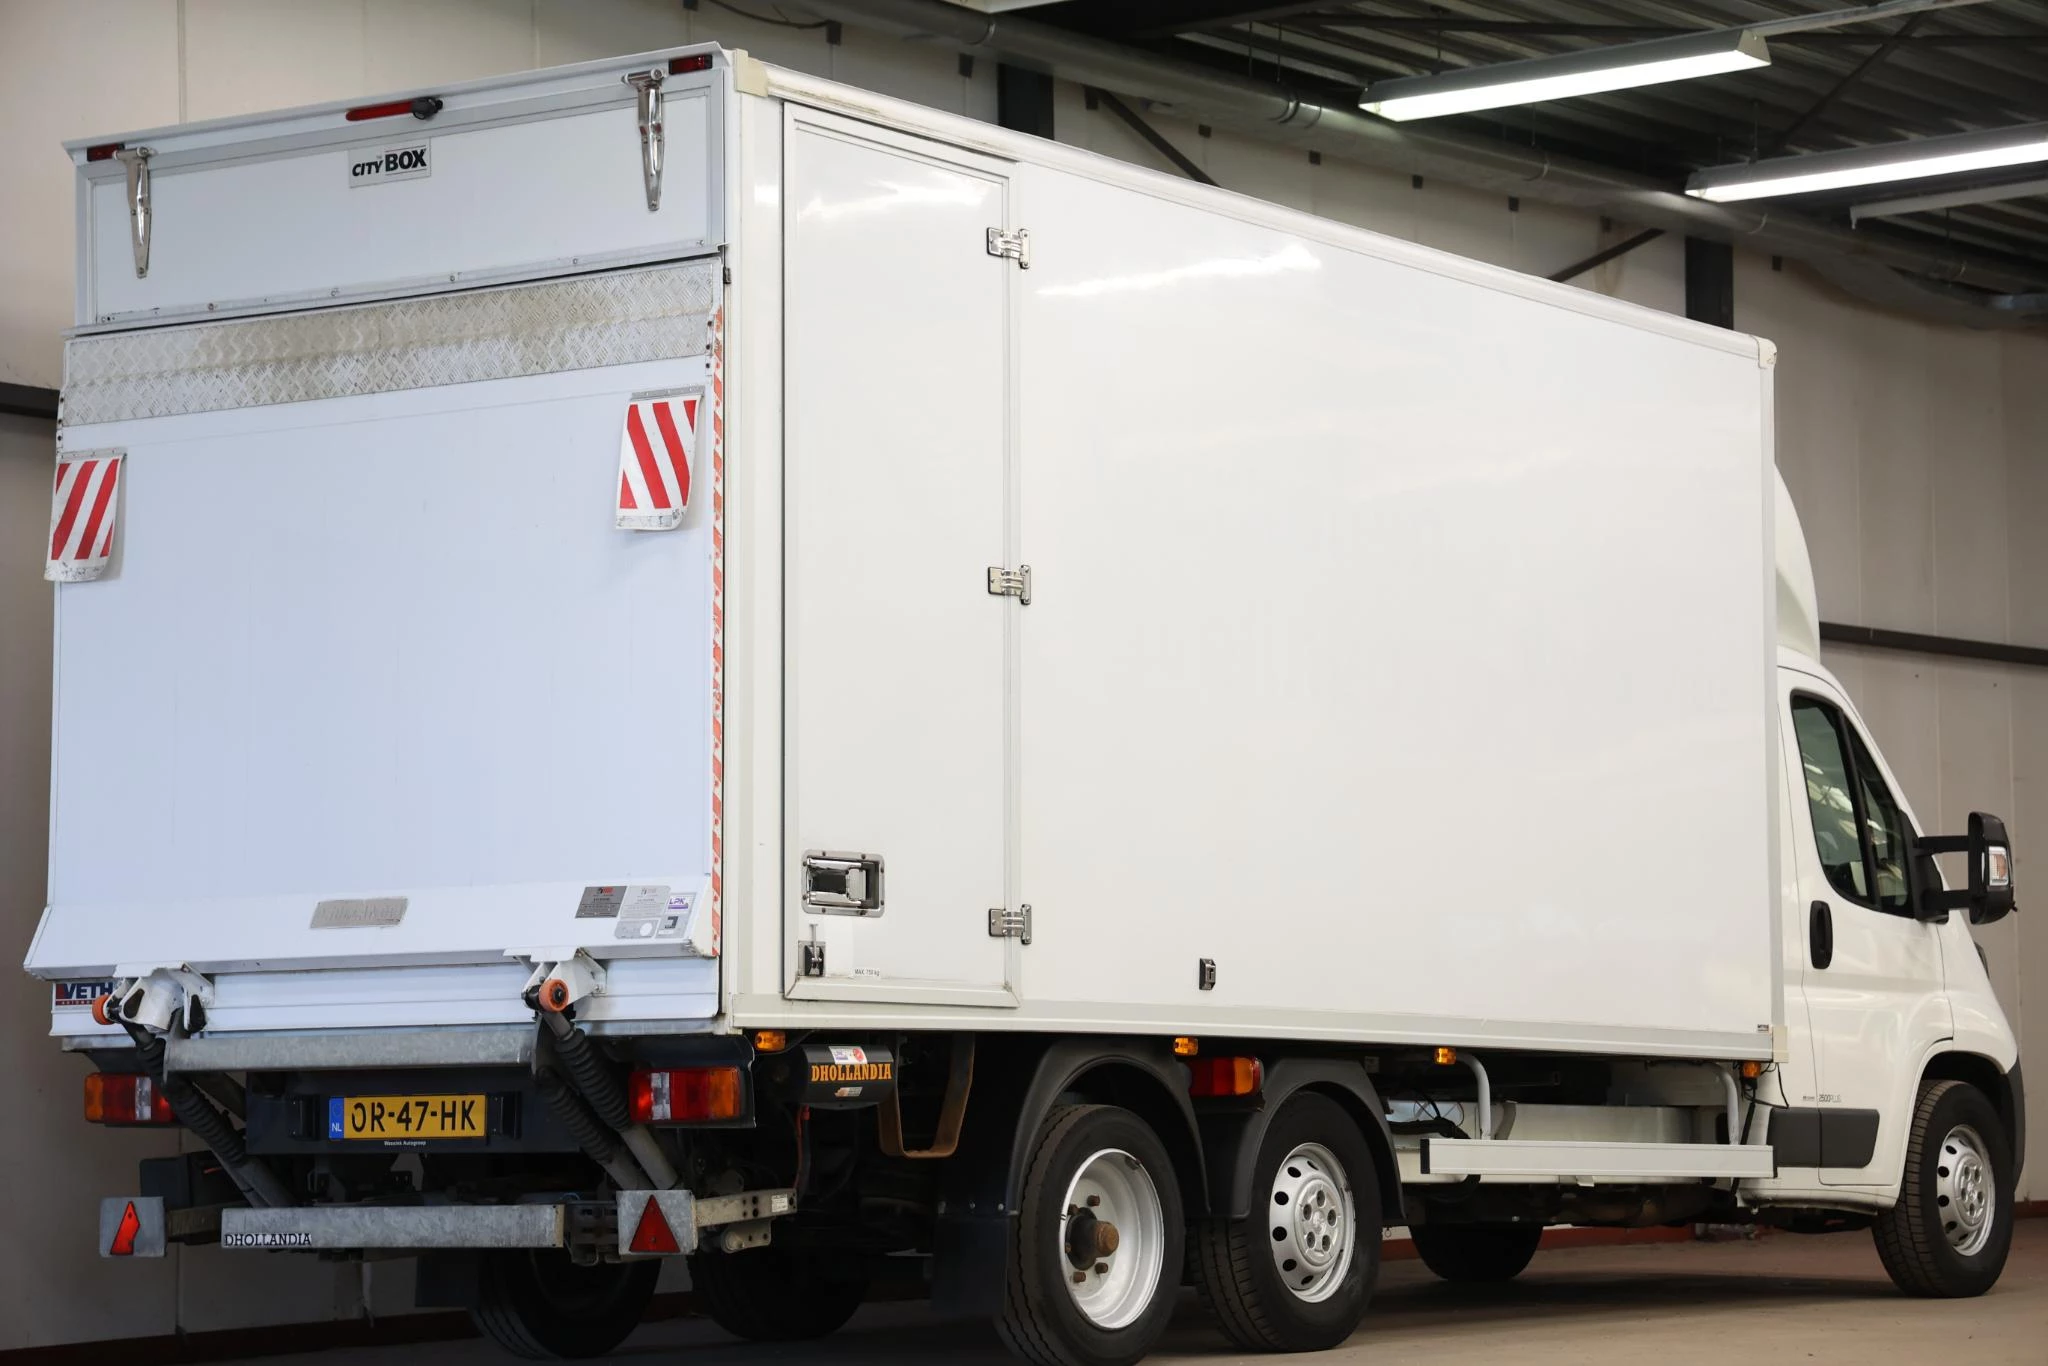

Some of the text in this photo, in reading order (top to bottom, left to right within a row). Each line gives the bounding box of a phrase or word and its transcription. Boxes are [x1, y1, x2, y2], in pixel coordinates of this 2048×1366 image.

[352, 148, 427, 177] CITY BOX
[63, 983, 113, 999] VETH
[811, 1063, 892, 1082] DHOLLANDIA
[331, 1100, 476, 1133] NL OR-47-HK
[224, 1233, 312, 1247] DHOLLANDIA
